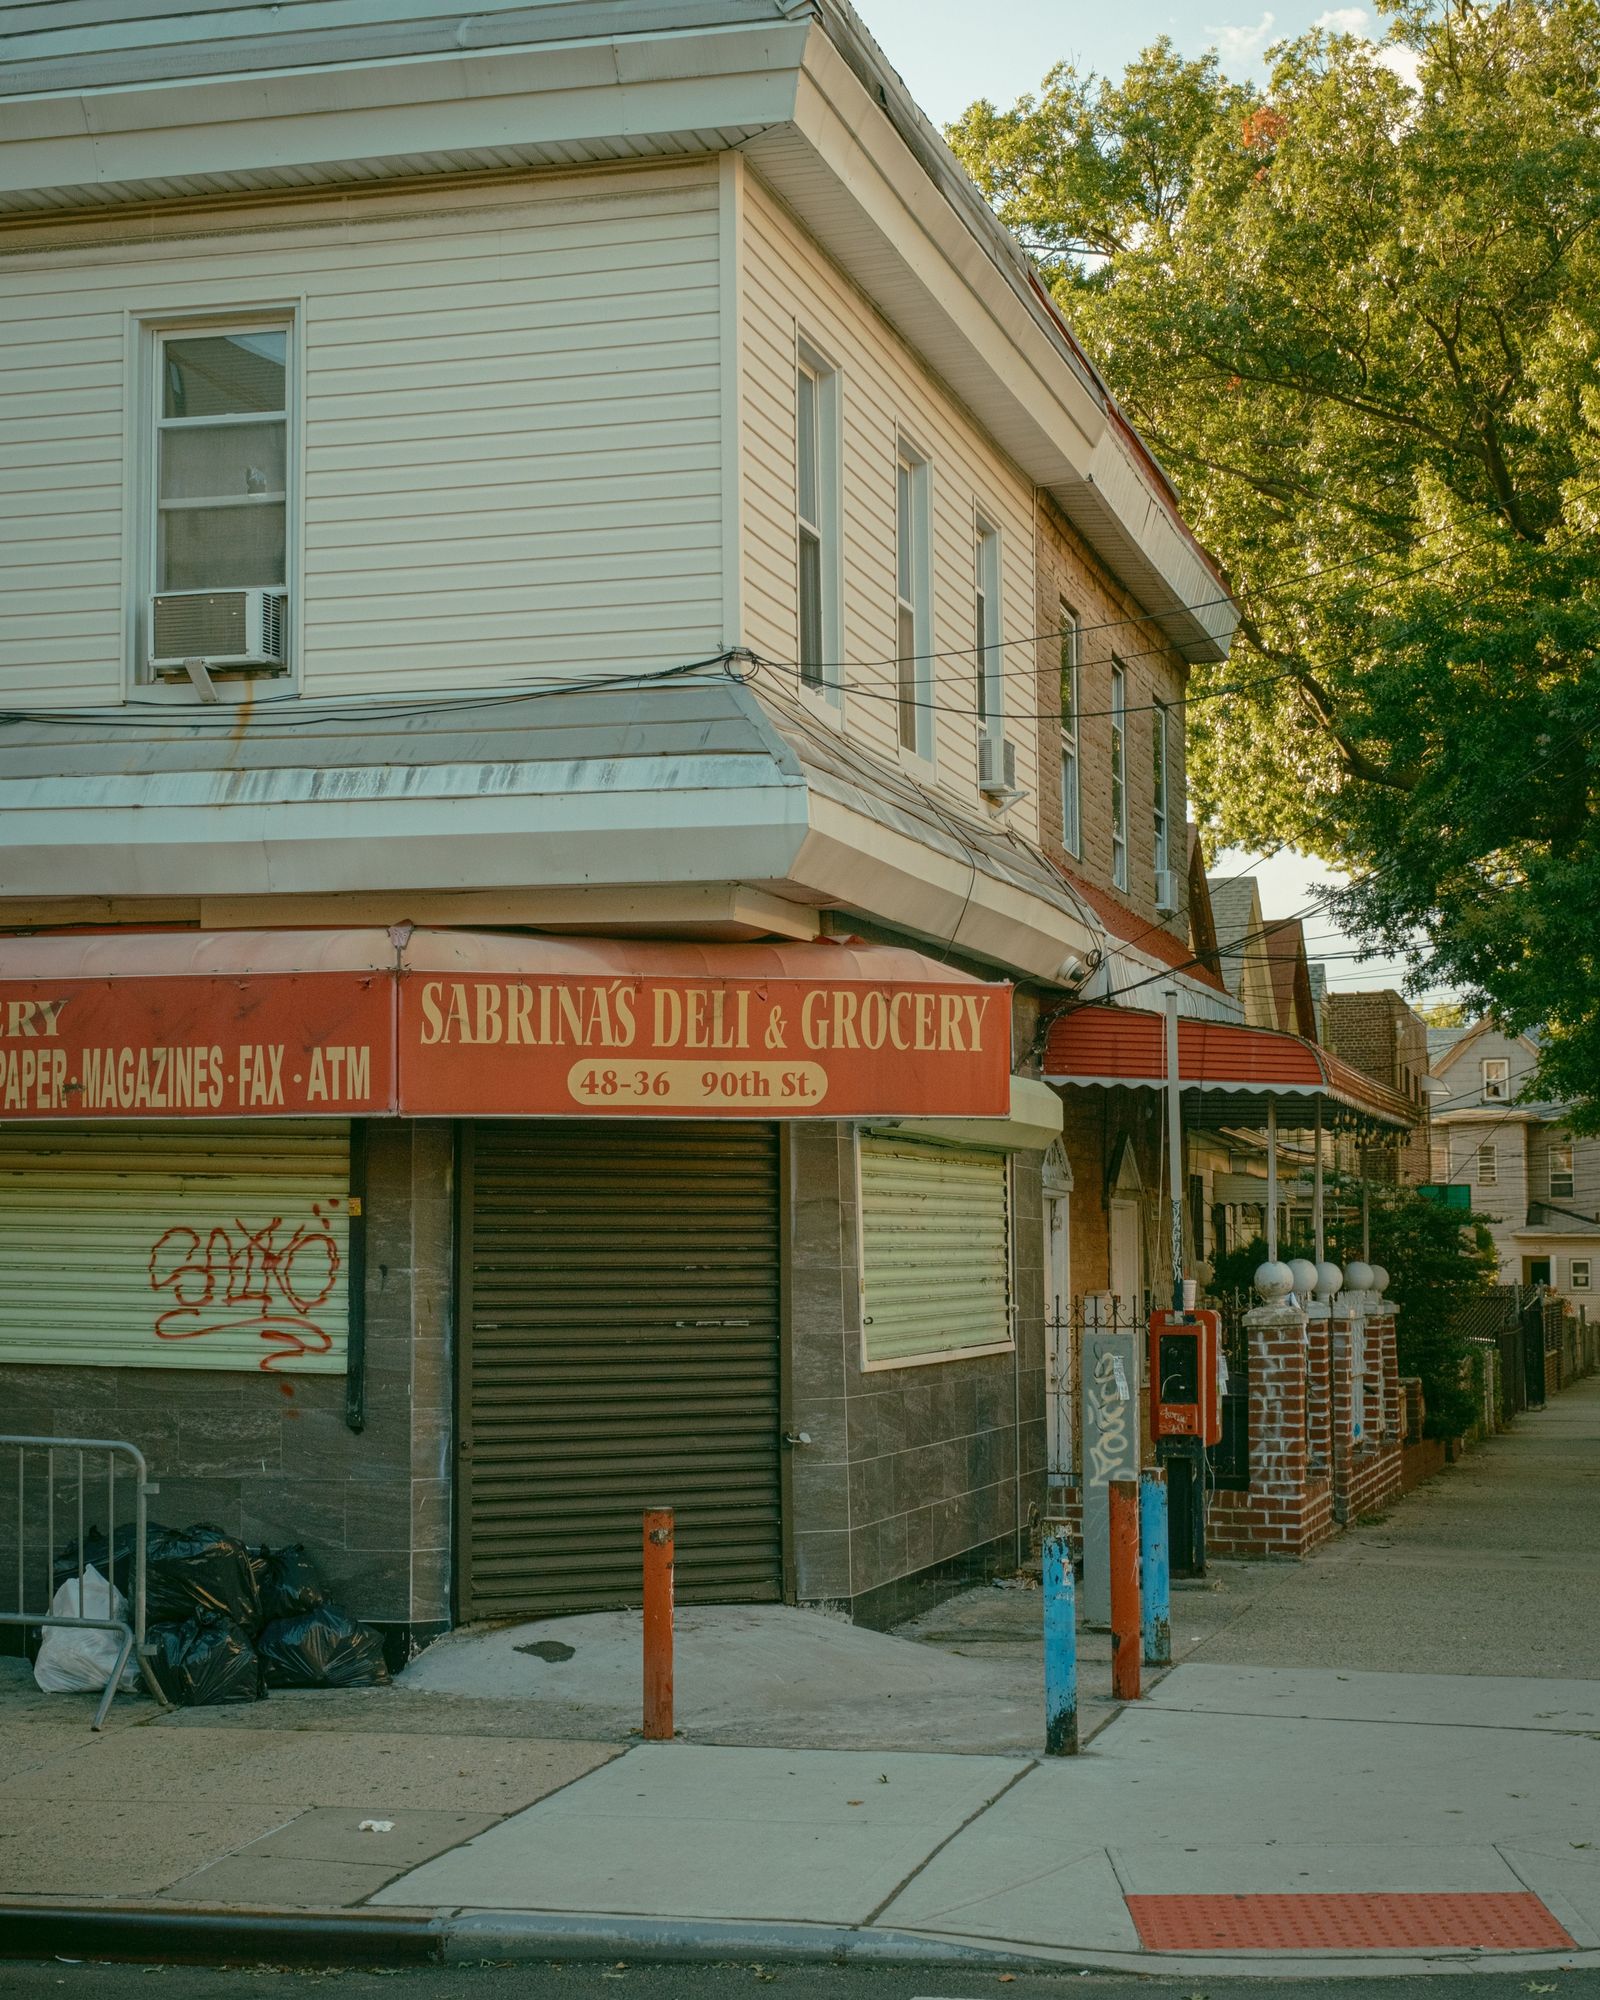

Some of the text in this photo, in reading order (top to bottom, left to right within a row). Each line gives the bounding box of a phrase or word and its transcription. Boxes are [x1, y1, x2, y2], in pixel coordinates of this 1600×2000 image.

[0, 1000, 68, 1037] RY
[421, 980, 991, 1052] SABRINA'S DELI & GROCERY
[82, 1045, 224, 1109] MAGAZINES
[239, 1044, 285, 1106] FAX
[307, 1045, 371, 1101] ATM
[580, 1070, 818, 1098] 48-36 90th St.
